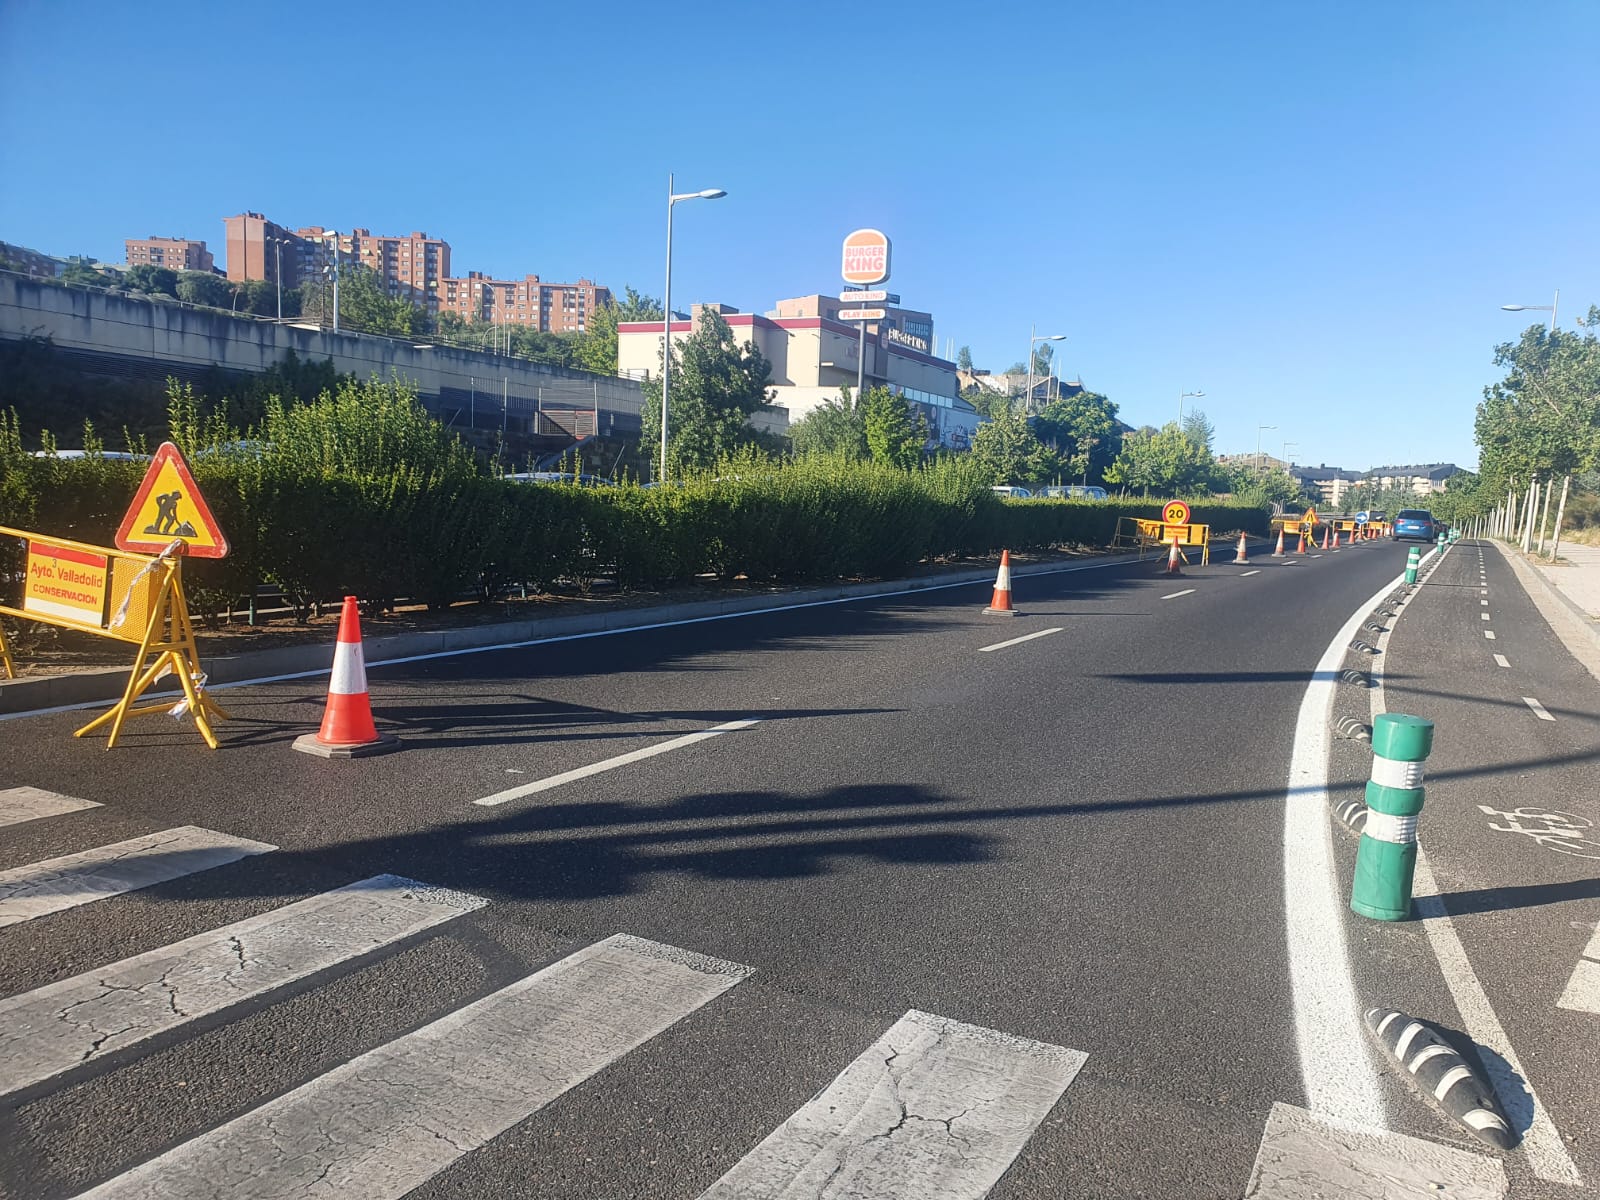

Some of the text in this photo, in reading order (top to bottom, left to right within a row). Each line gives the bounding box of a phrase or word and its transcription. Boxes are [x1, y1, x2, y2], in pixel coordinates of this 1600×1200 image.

[845, 246, 884, 258] BURGER
[844, 257, 884, 272] KING
[843, 291, 884, 300] AUTO KING
[842, 310, 881, 319] PLAY KING
[1168, 509, 1184, 519] 20
[30, 561, 103, 588] Ayto. Valladolid
[32, 583, 98, 605] CONSERVACION
